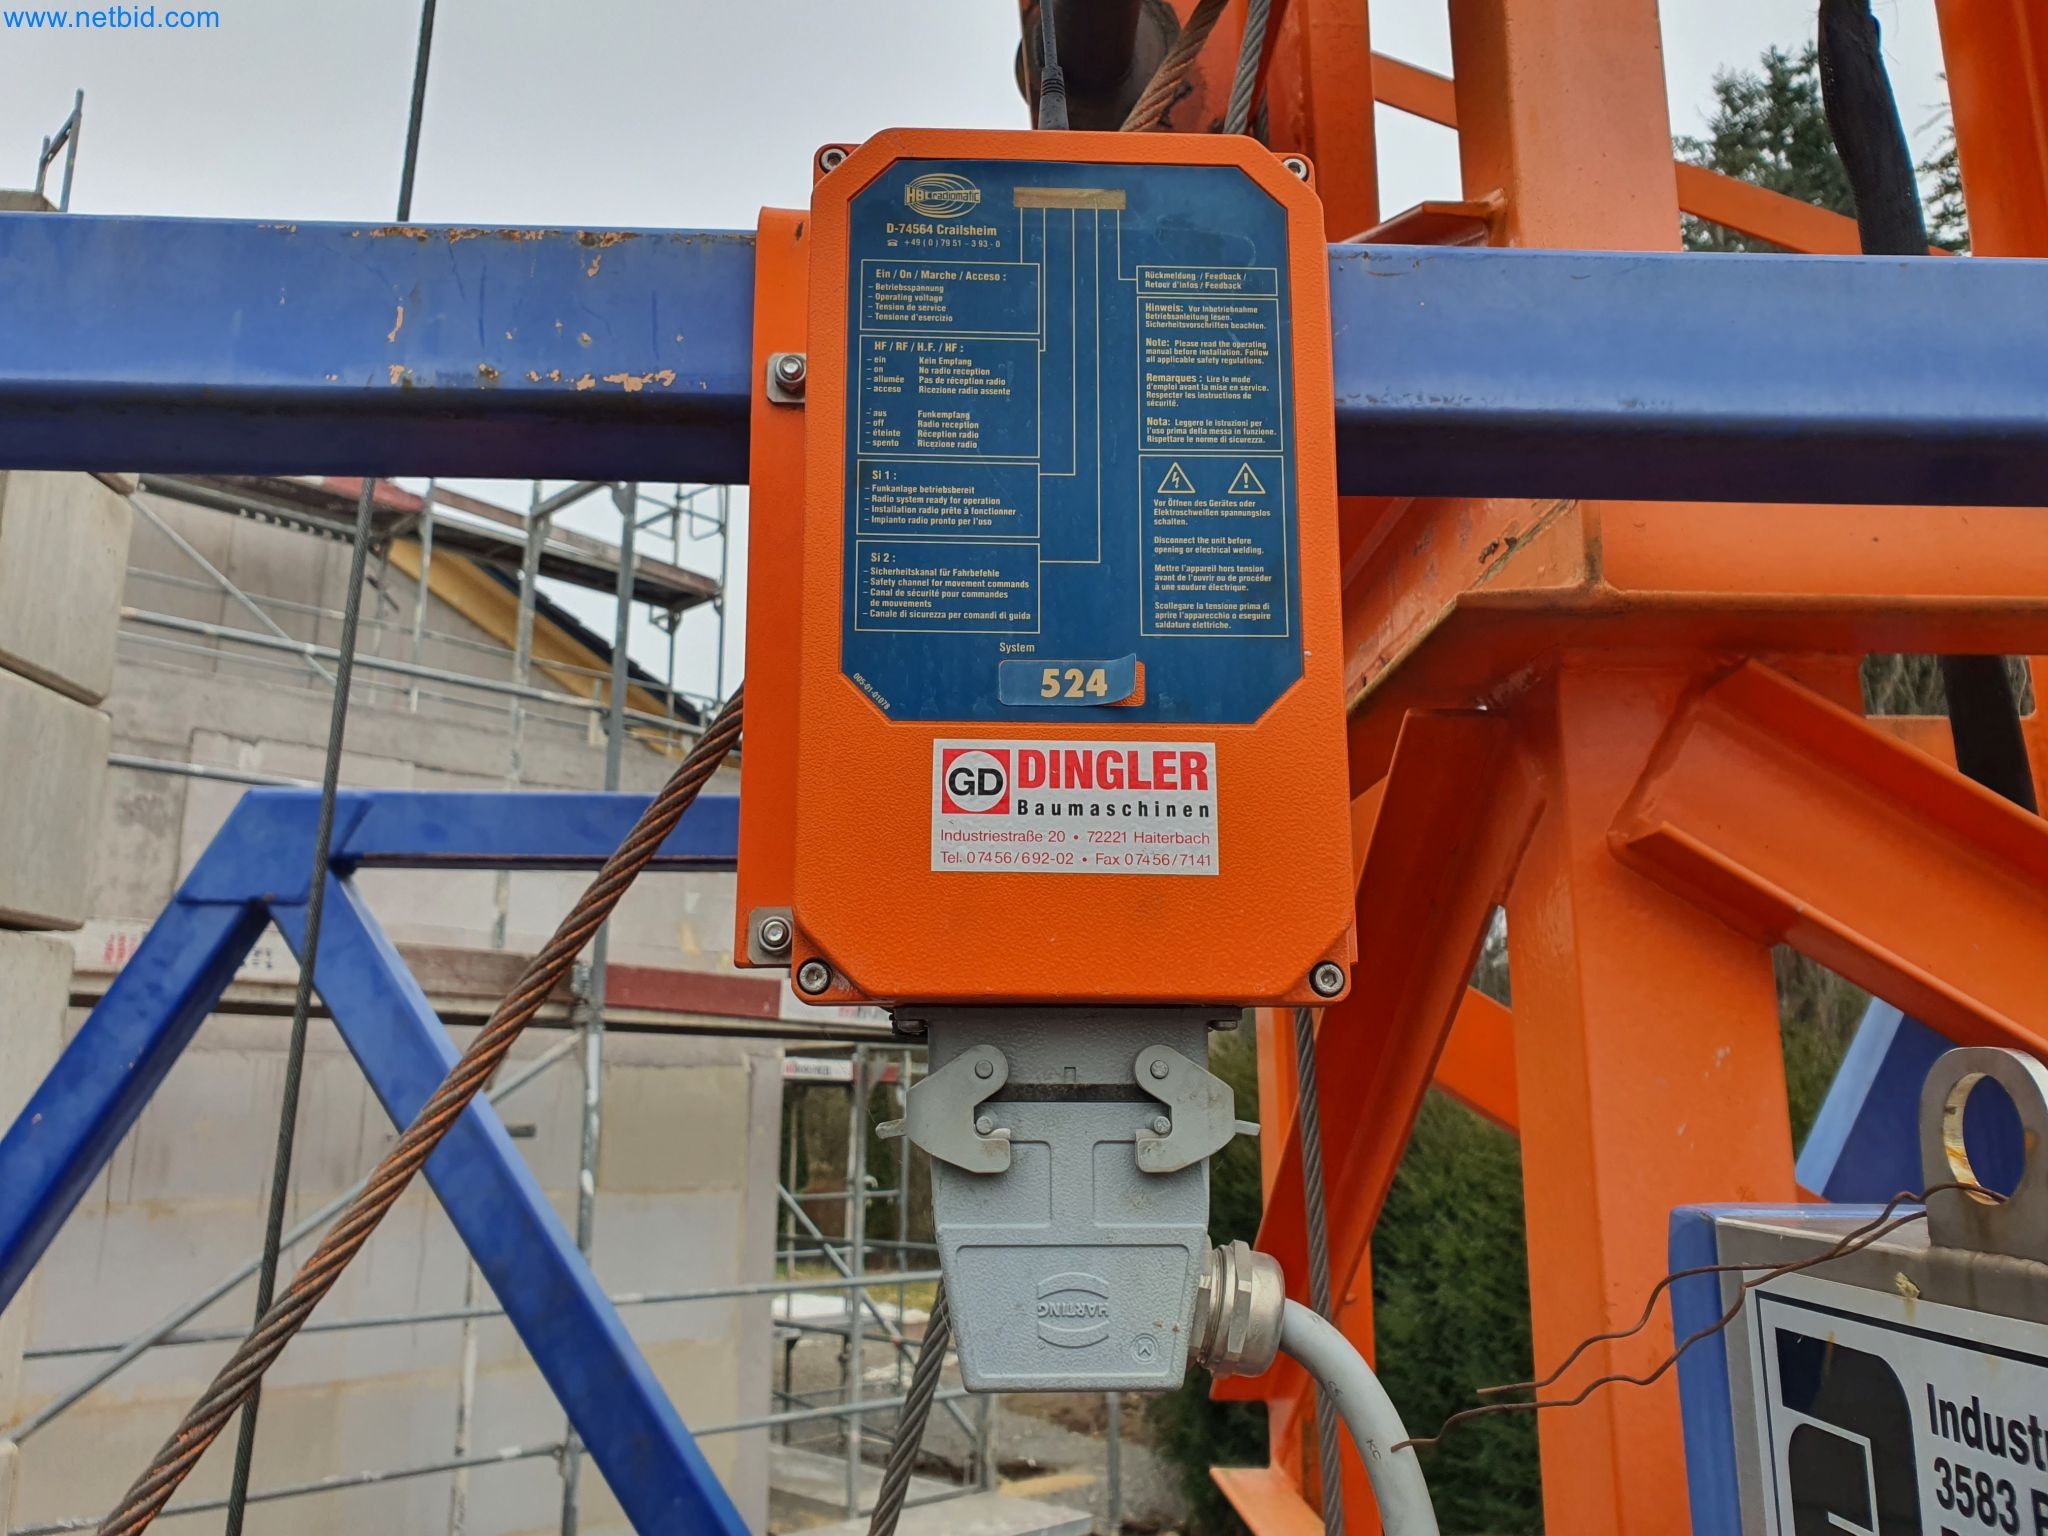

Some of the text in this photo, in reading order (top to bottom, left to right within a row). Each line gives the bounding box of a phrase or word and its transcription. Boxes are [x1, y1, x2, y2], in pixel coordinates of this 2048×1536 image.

[932, 189, 980, 202] radiomatic
[886, 223, 997, 235] D-74564 Crailsheim
[876, 269, 890, 278] Ein
[900, 270, 912, 279] On
[921, 270, 956, 280] Marche
[876, 284, 944, 293] Betriebsspannung
[875, 294, 943, 303] Operating voltage
[1146, 338, 1169, 346] Note:
[875, 342, 886, 350] HF
[896, 342, 908, 351] RF
[945, 343, 957, 352] HF
[939, 358, 972, 366] Empfang
[953, 368, 990, 376] reception
[874, 375, 904, 383] allumée
[947, 377, 984, 385] réception
[1146, 374, 1196, 383] Remarques
[918, 411, 970, 419] Funkempfang
[942, 421, 979, 429] reception
[1147, 417, 1170, 425] Nota:
[918, 430, 957, 439] Réception
[918, 440, 955, 448] Ricezione
[872, 471, 889, 480] Si 1
[872, 485, 917, 494] Funkanlage
[896, 496, 924, 504] system
[926, 496, 947, 504] ready
[963, 497, 1000, 506] operation
[919, 506, 939, 514] radio
[941, 507, 962, 515] prête
[971, 507, 1016, 515] fonctionner
[872, 516, 906, 525] Impianto
[930, 517, 956, 525] pronto
[871, 553, 889, 562] Si 2
[871, 568, 937, 576] Sicherheitskanal
[871, 578, 895, 586] Safety
[945, 579, 985, 587] movement
[962, 590, 1008, 598] commandes
[909, 610, 946, 618] sicurezza
[964, 611, 997, 619] comandi
[1009, 612, 1030, 620] guida
[1000, 643, 1035, 653] System
[1040, 668, 1108, 698] 524
[1018, 750, 1208, 790] DINGLER
[948, 767, 1004, 796] GD
[1018, 799, 1209, 818] Baumaschinen
[941, 830, 1209, 845] Industriestraße 20 72221 Haiterbach
[941, 851, 962, 864] Tel.
[1096, 853, 1120, 866] Fax
[1037, 1302, 1109, 1318] HARTING
[1933, 1456, 2020, 1536] 3583
